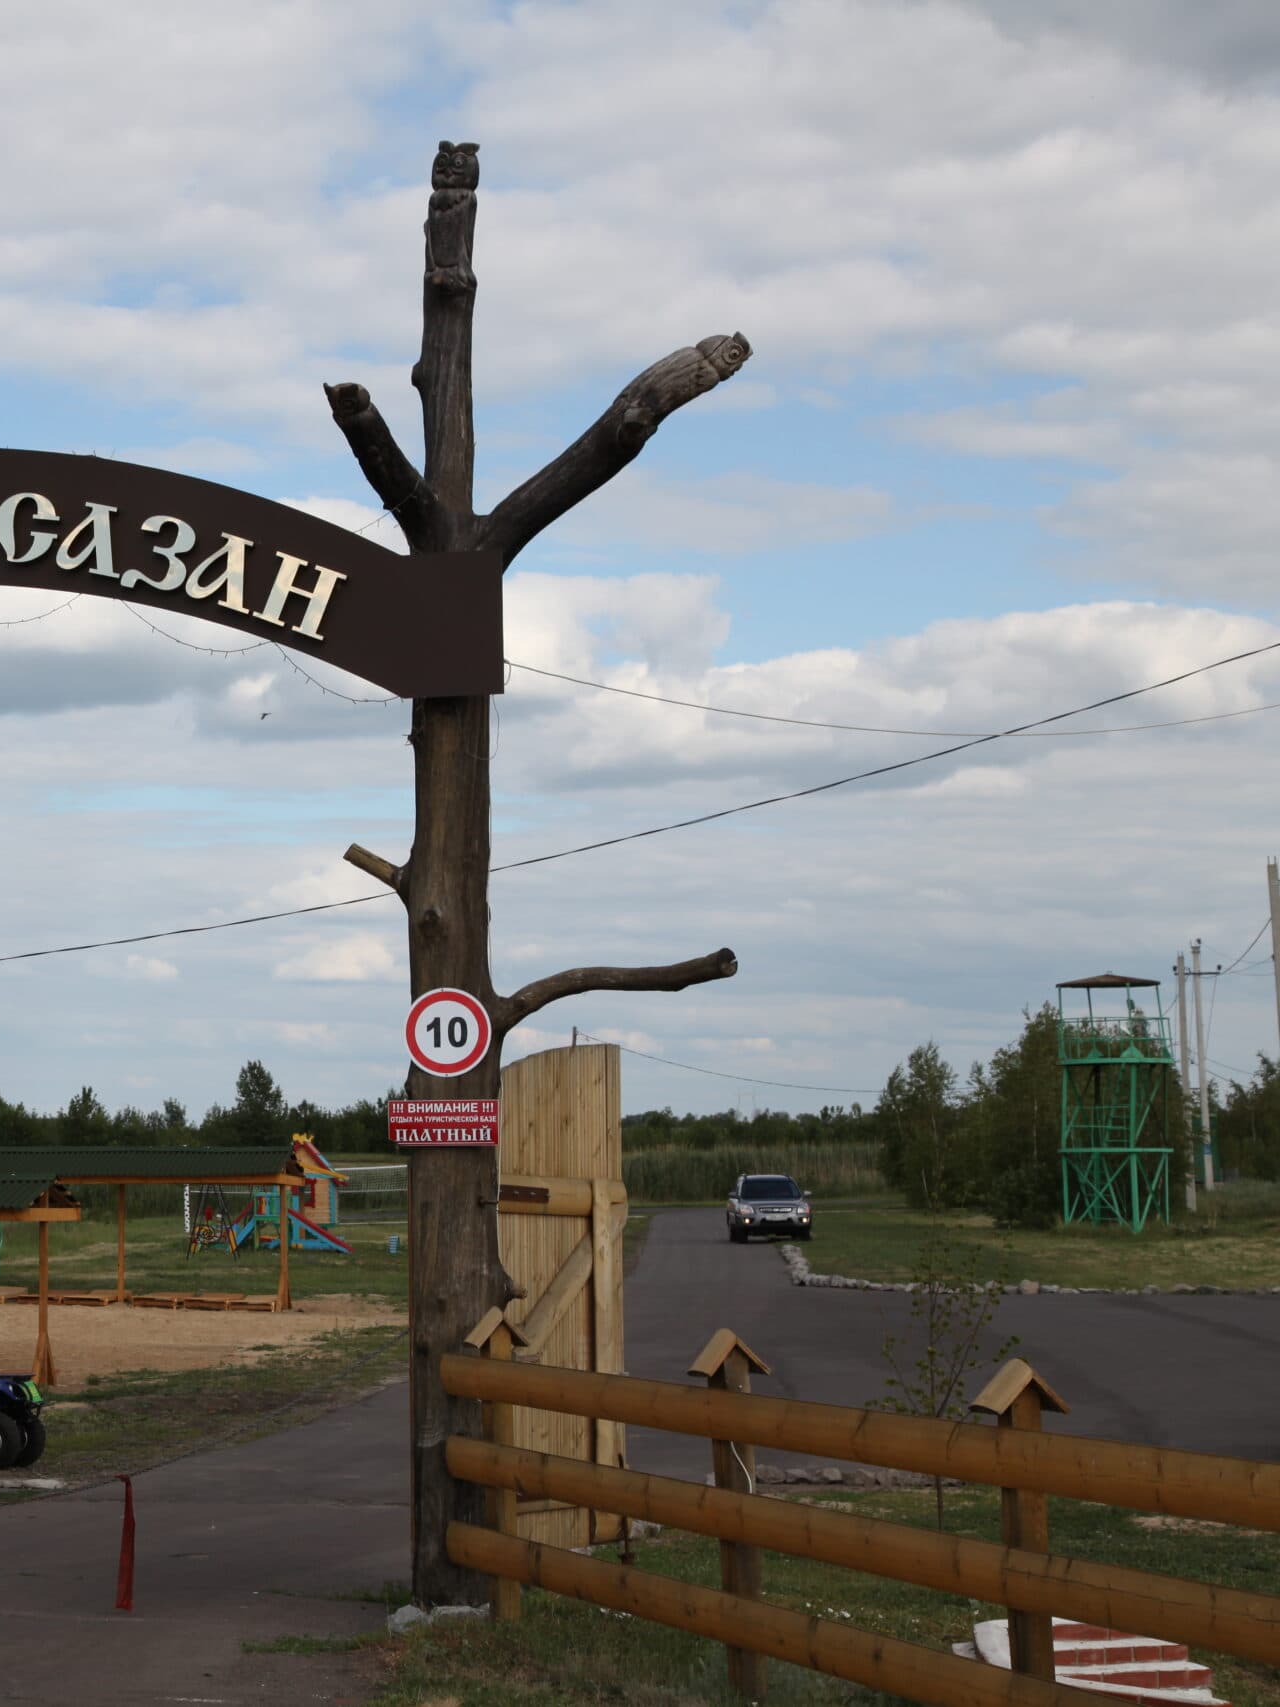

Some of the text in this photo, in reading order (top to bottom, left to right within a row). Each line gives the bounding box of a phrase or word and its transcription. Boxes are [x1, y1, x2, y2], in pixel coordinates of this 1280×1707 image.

[426, 1016, 468, 1048] 10
[407, 1102, 478, 1113] ВНИМАНИЕ
[424, 1115, 479, 1123] ТУРИСТИЧЕСКОЙ
[395, 1125, 493, 1142] ПЛАТНЫЙ
